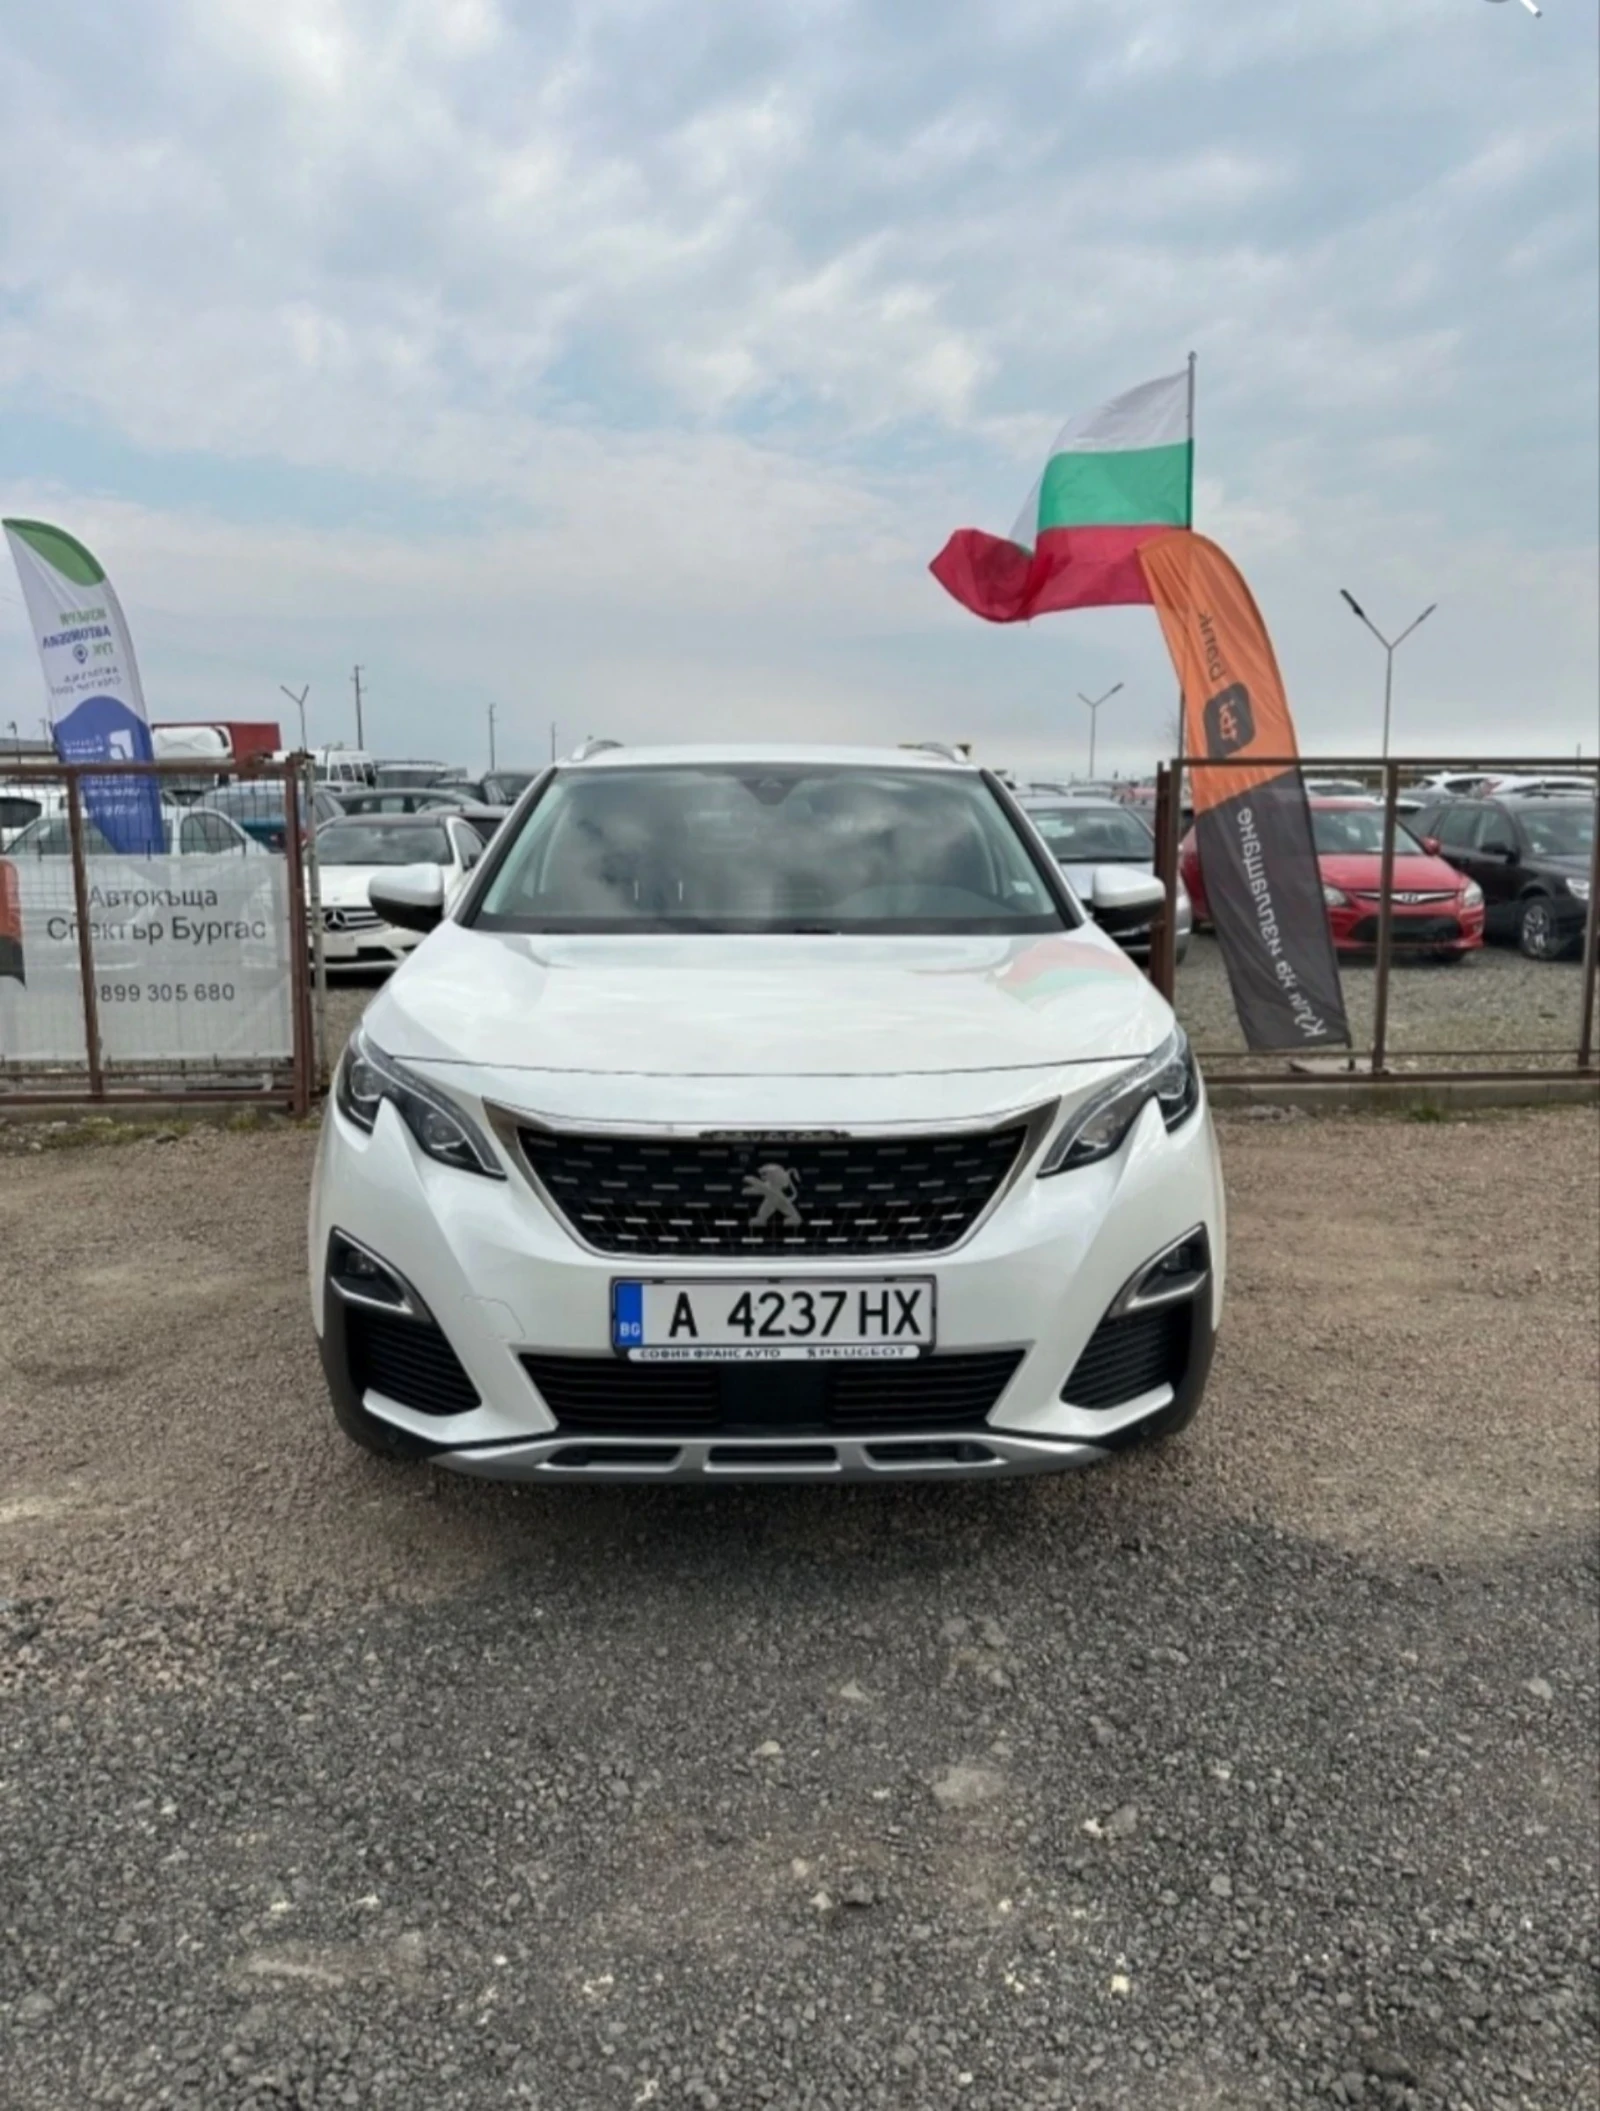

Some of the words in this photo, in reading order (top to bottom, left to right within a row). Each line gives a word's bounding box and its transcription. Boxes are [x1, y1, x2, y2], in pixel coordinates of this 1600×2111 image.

[88, 886, 218, 910] Автокъща
[171, 915, 267, 946] Бургас
[94, 983, 141, 1001] 899
[147, 983, 188, 1001] 305
[194, 982, 235, 1001] 680
[620, 1322, 641, 1337] BG
[745, 1349, 781, 1359] АУТО
[819, 1347, 906, 1357] PEUGEOT
